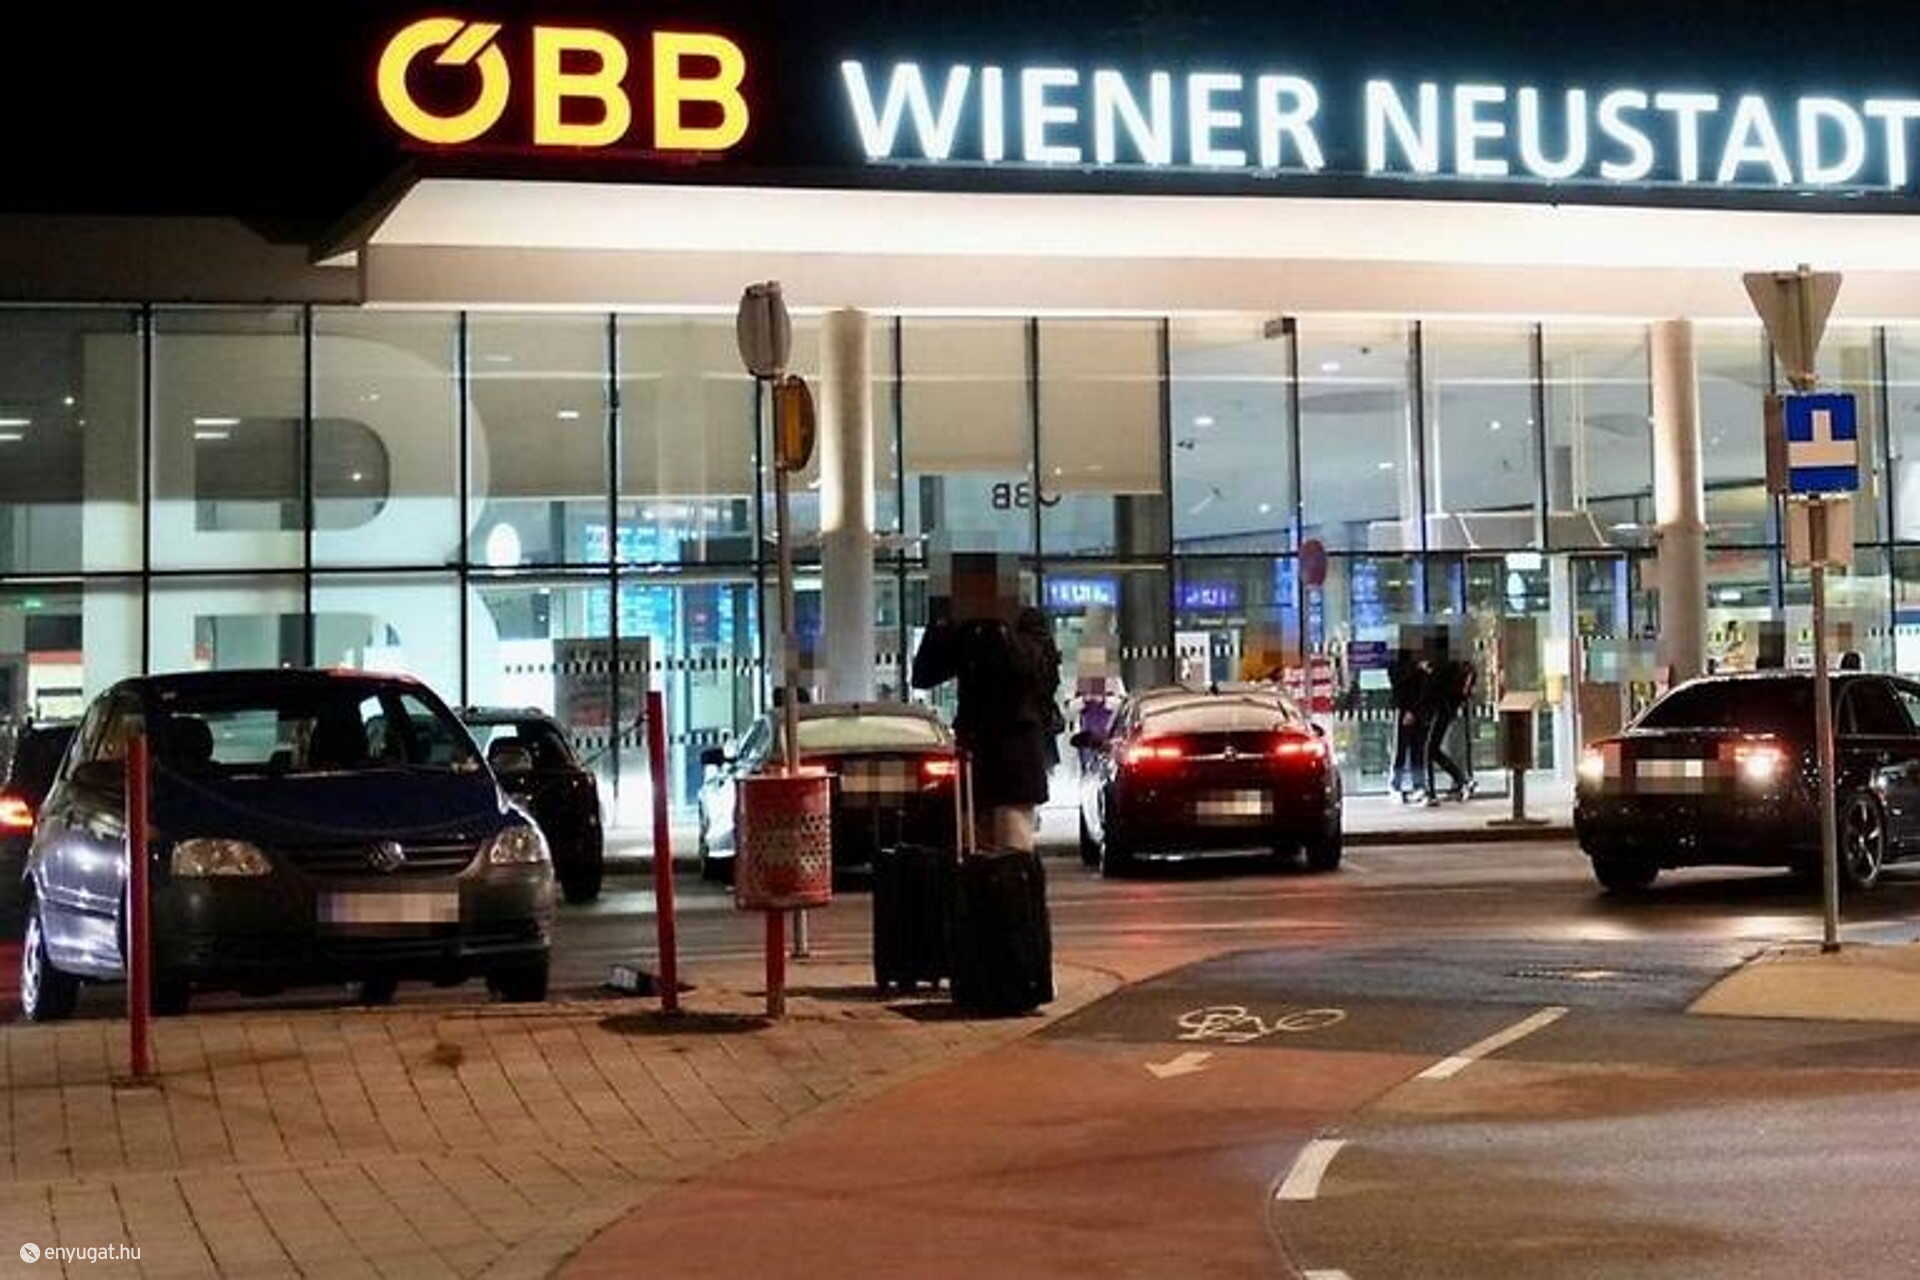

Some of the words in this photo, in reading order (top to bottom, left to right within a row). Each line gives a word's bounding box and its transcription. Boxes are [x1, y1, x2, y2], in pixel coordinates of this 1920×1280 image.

[377, 17, 750, 151] ÖBB
[841, 60, 1325, 171] WIENER
[1366, 79, 1920, 187] NEUSTADT
